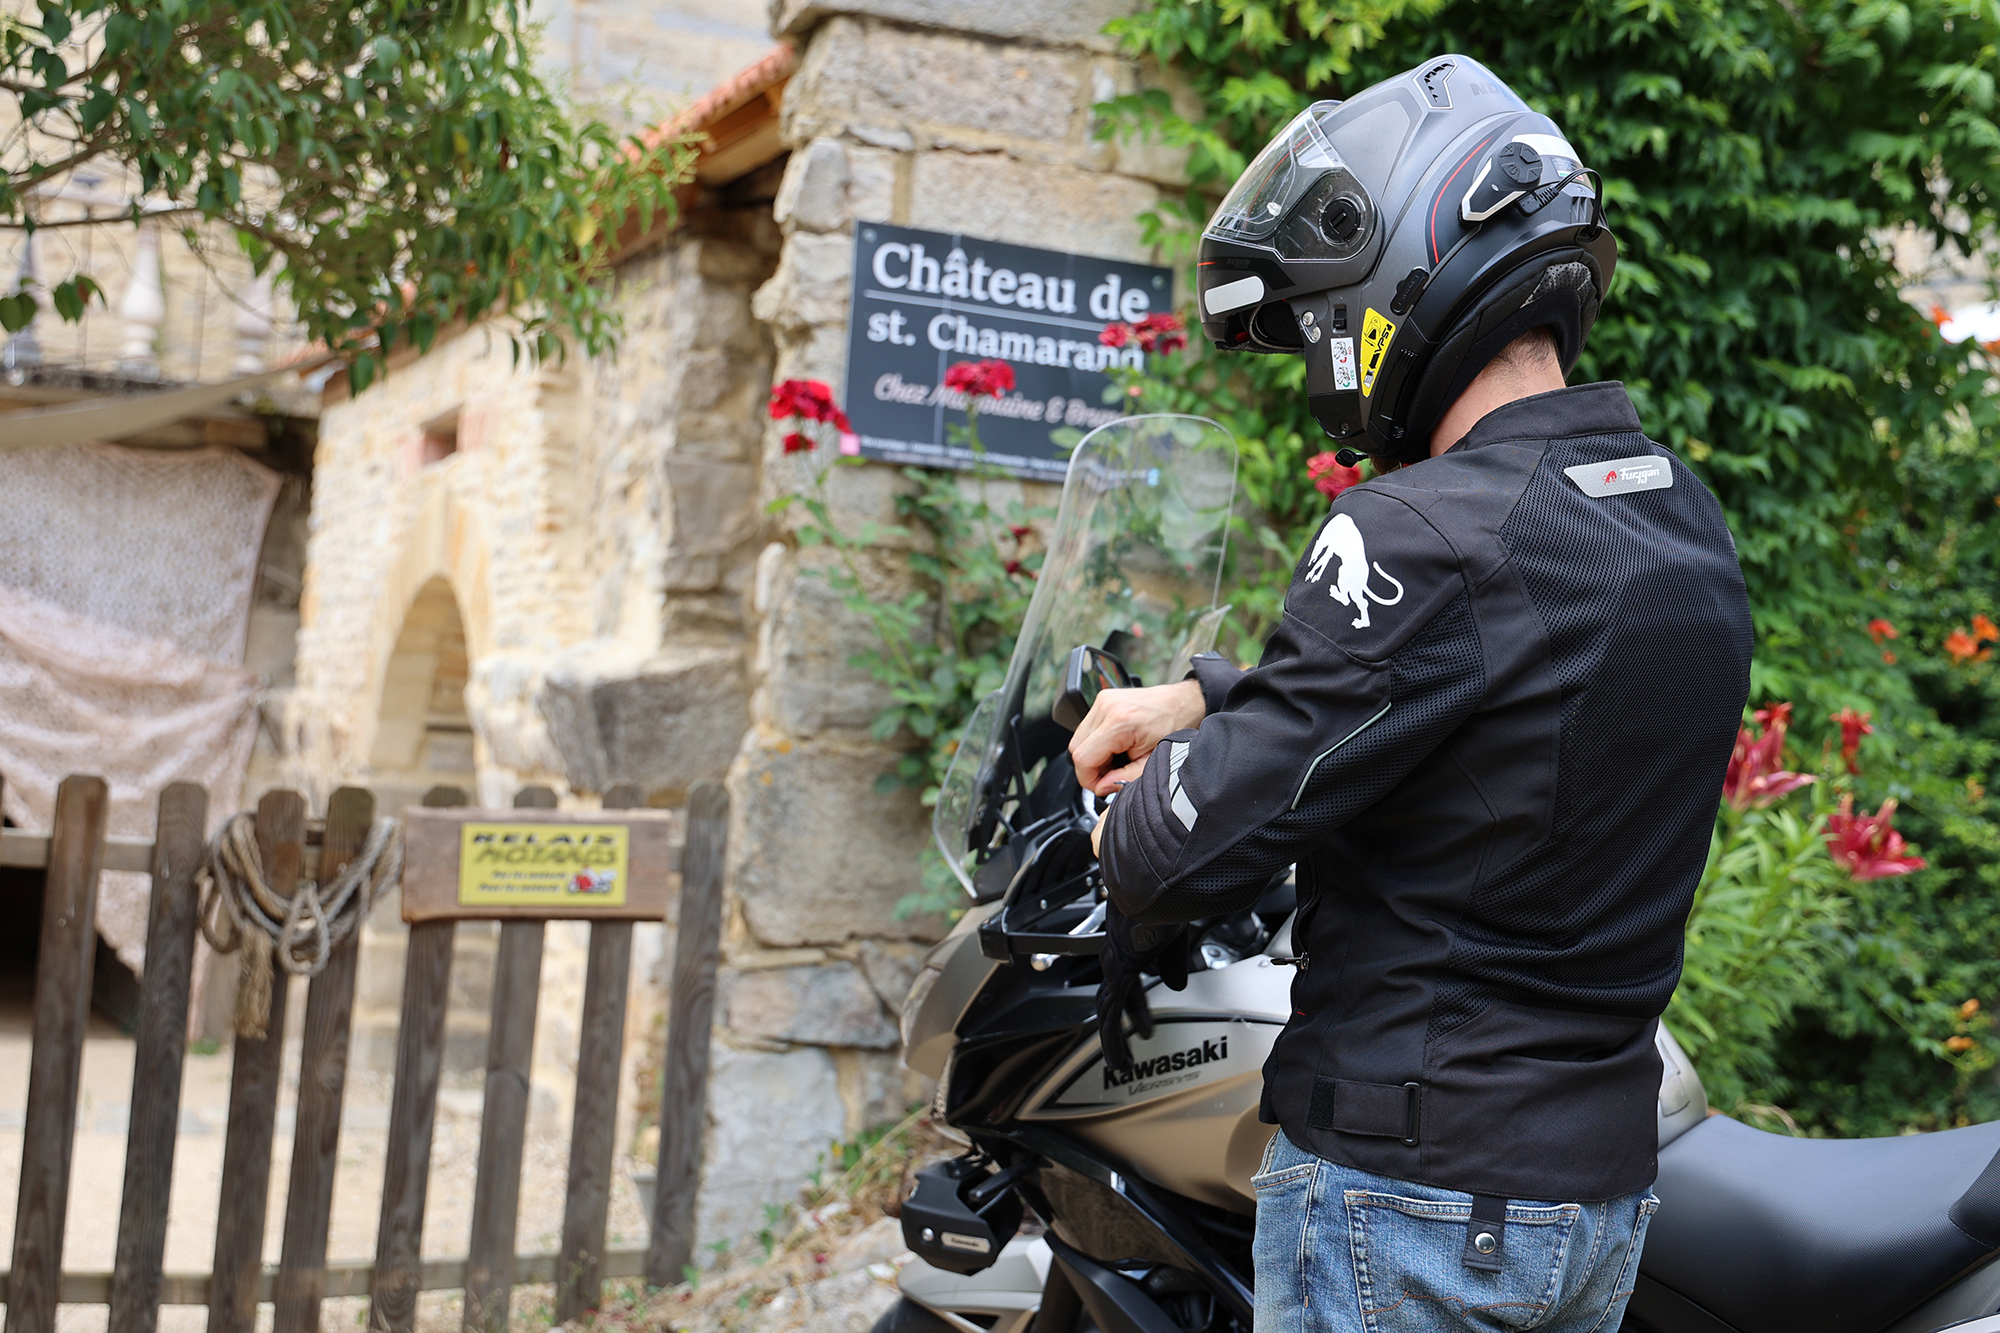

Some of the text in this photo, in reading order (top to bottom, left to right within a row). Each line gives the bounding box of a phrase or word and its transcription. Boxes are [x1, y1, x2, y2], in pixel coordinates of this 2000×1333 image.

[872, 242, 1150, 324] Château de
[867, 309, 916, 347] st.
[874, 372, 930, 406] Chez
[1103, 1035, 1228, 1091] Kawasaki
